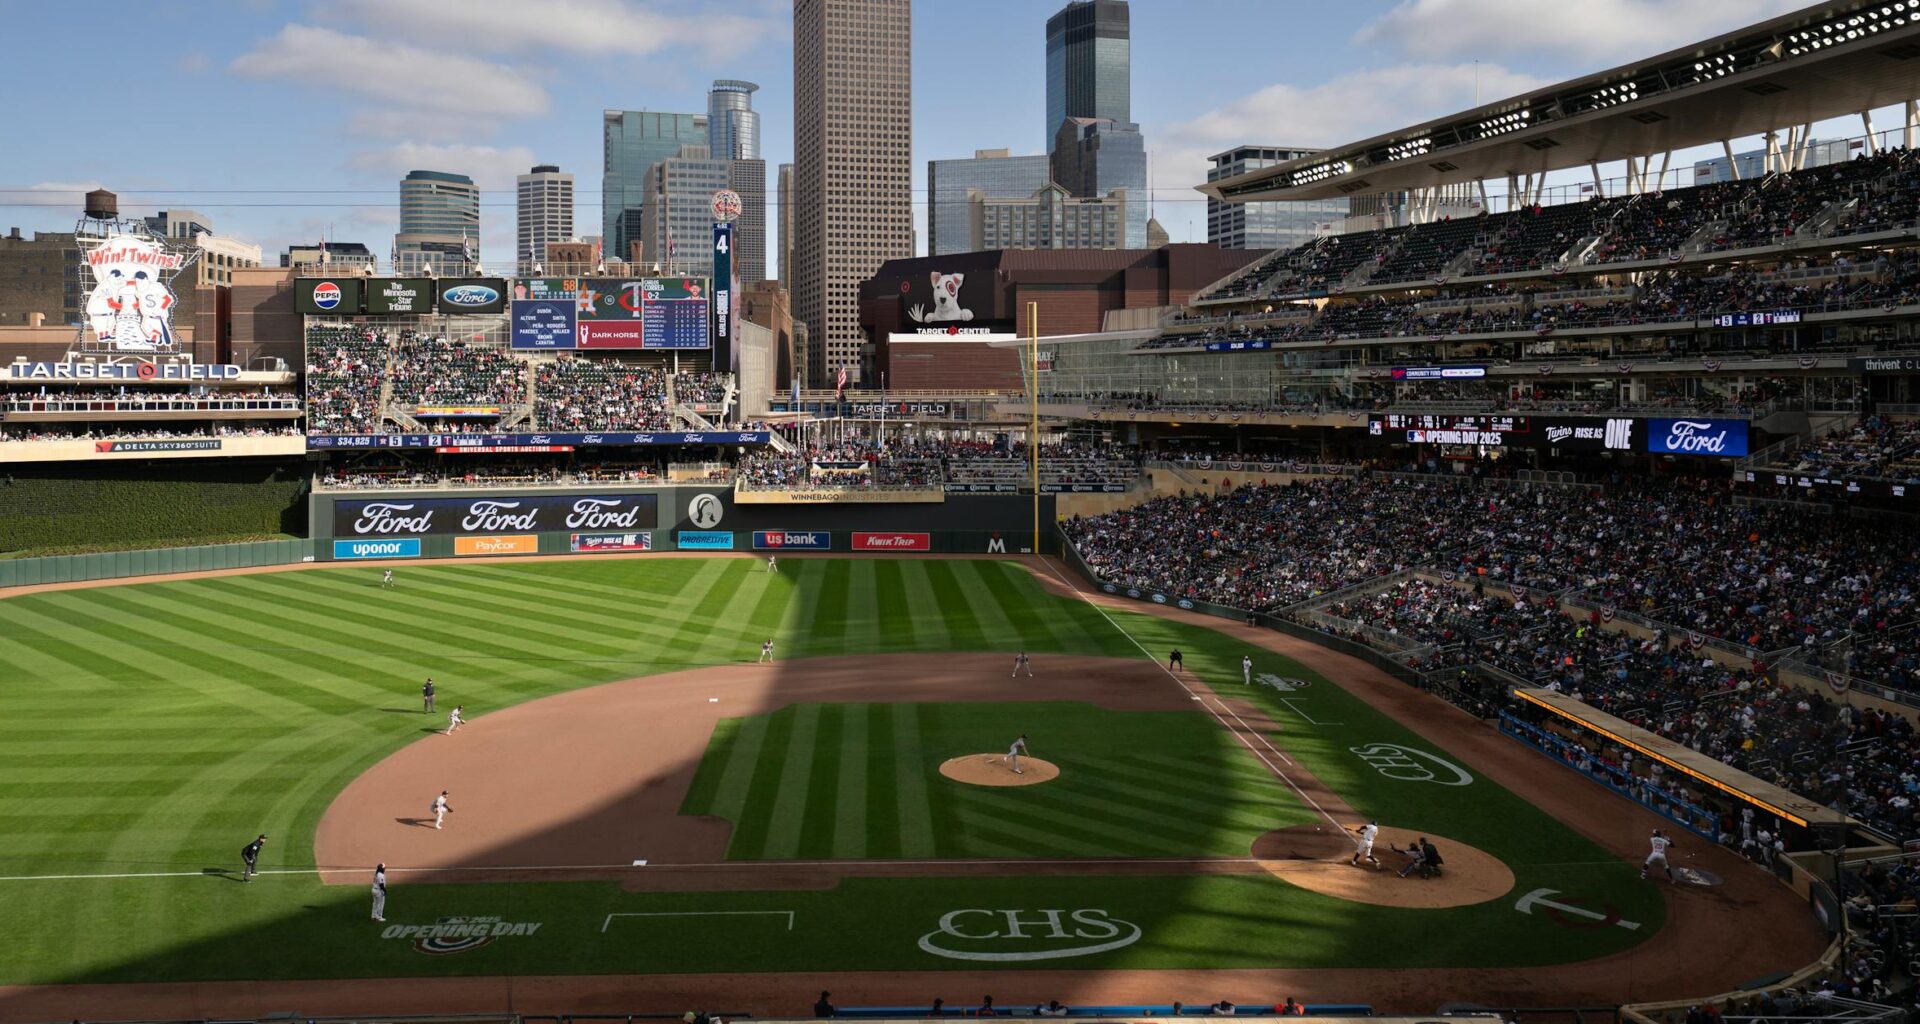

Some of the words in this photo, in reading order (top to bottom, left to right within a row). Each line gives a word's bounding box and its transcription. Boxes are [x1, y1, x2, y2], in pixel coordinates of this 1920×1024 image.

[716, 234, 728, 254] 4
[88, 248, 127, 266] Win!
[129, 248, 183, 269] Twins!
[391, 282, 402, 290] The
[563, 280, 575, 291] 58
[682, 279, 690, 291] 4
[383, 289, 416, 297] Minnesota
[453, 289, 488, 303] Ford
[647, 291, 660, 299] 0-2
[397, 296, 413, 305] Star
[388, 303, 412, 311] Tribune
[1724, 316, 1730, 325] 5
[1756, 314, 1761, 324] 2
[1865, 358, 1901, 370] thrivent
[12, 363, 134, 379] TARGET
[163, 364, 242, 380] FIELD
[851, 405, 897, 413] TARGET
[911, 404, 945, 413] FIELD
[530, 435, 551, 444] Ford
[583, 434, 602, 444] Ford
[633, 434, 653, 443] Ford
[683, 433, 703, 442] Ford
[738, 433, 758, 442] Ford
[1426, 431, 1462, 443] OPENING
[1462, 432, 1479, 443] DAY
[1479, 432, 1501, 444] 2025
[1545, 426, 1573, 442] Twins
[1574, 427, 1594, 439] RISE
[1593, 428, 1603, 439] AS
[1605, 418, 1633, 450] ONE
[1666, 420, 1727, 452] Ford
[195, 441, 220, 449] SUITE
[392, 436, 398, 446] 5
[432, 436, 438, 446] 2
[354, 503, 434, 534] Ford
[462, 500, 539, 531] Ford
[565, 498, 640, 529] Ford
[585, 537, 602, 547] Twins
[623, 534, 637, 546] ONE
[680, 535, 730, 544] PROGRESSIVE
[766, 535, 782, 544] us
[784, 533, 817, 544] bank
[353, 542, 402, 557] uponor
[475, 541, 517, 552] Paycor
[1349, 745, 1435, 781] CHS
[469, 916, 502, 924] 2025
[938, 909, 1120, 939] CHS
[381, 922, 492, 939] OPENING
[492, 922, 543, 936] DAY
